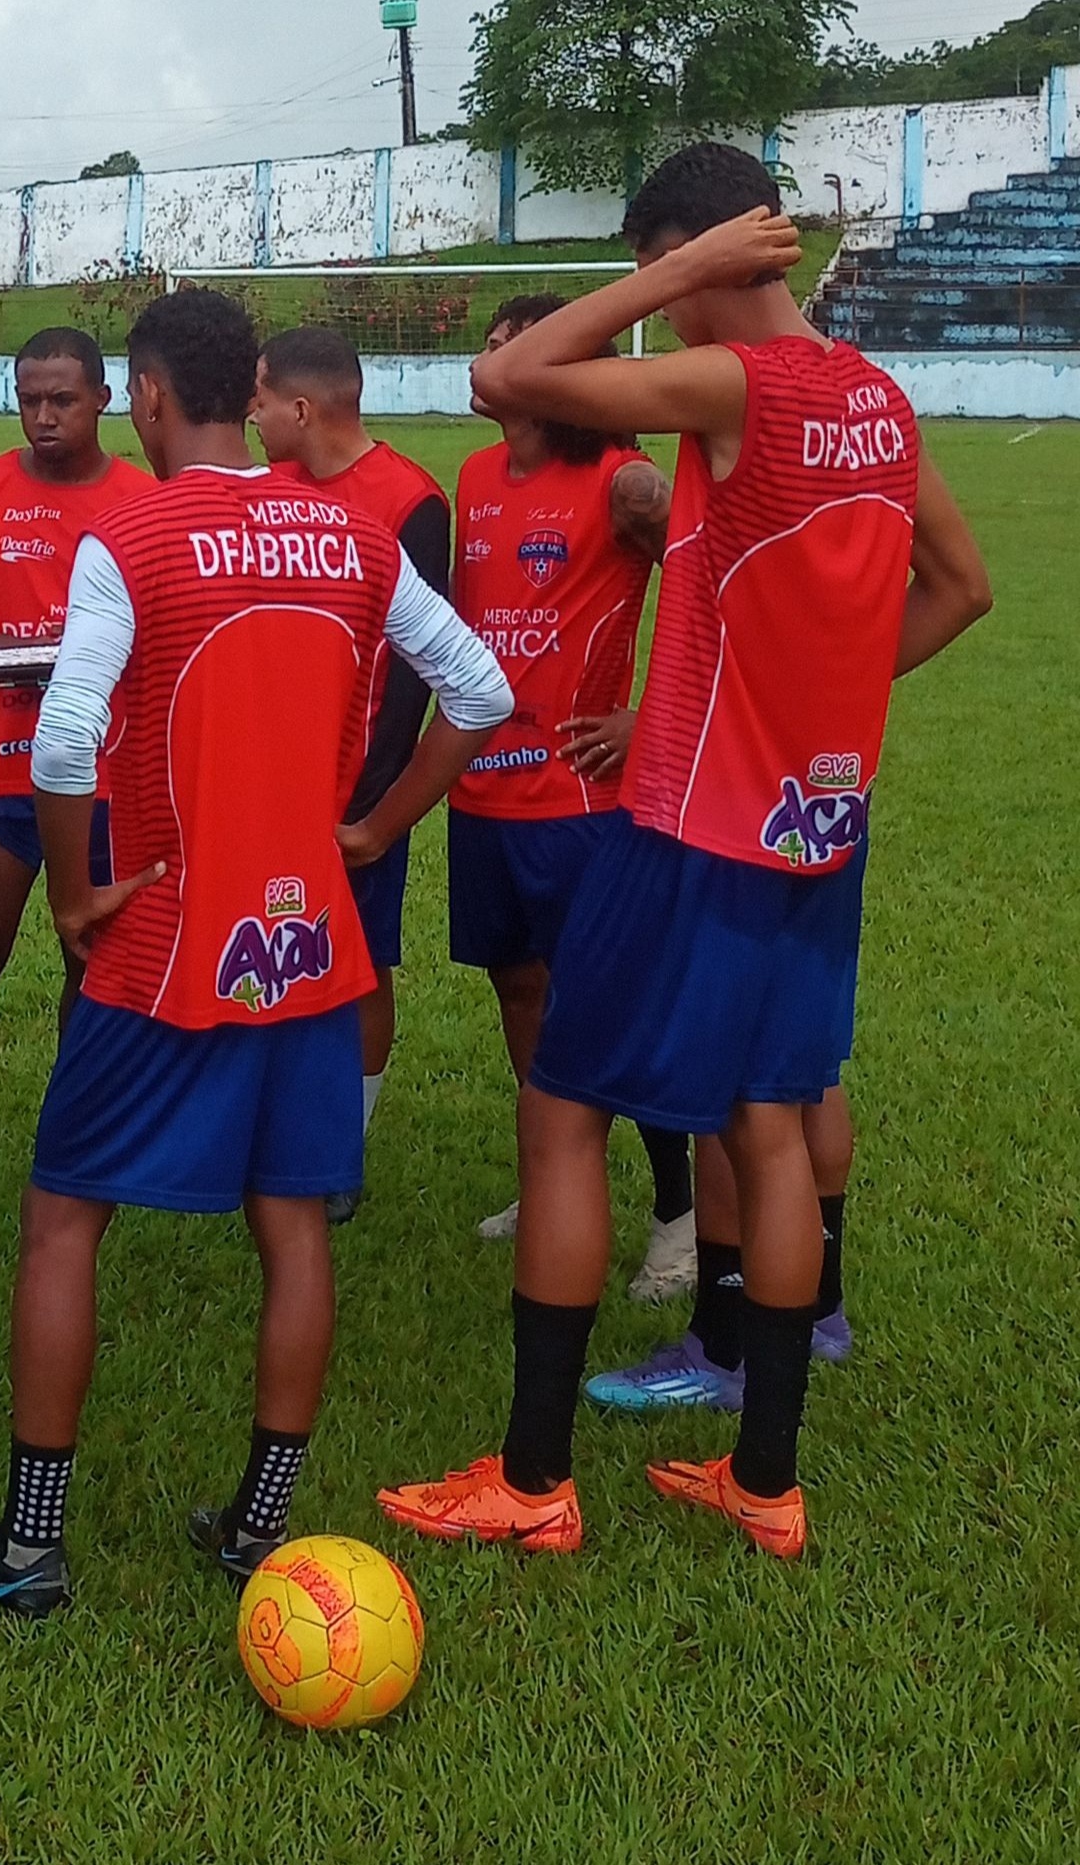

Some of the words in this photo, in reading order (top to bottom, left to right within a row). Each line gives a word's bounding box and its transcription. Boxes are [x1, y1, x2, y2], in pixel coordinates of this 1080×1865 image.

[247, 500, 349, 527] MERCADO
[188, 520, 364, 582] DFÁBRICA
[483, 607, 559, 625] MERCADO
[473, 622, 560, 658] BRICA
